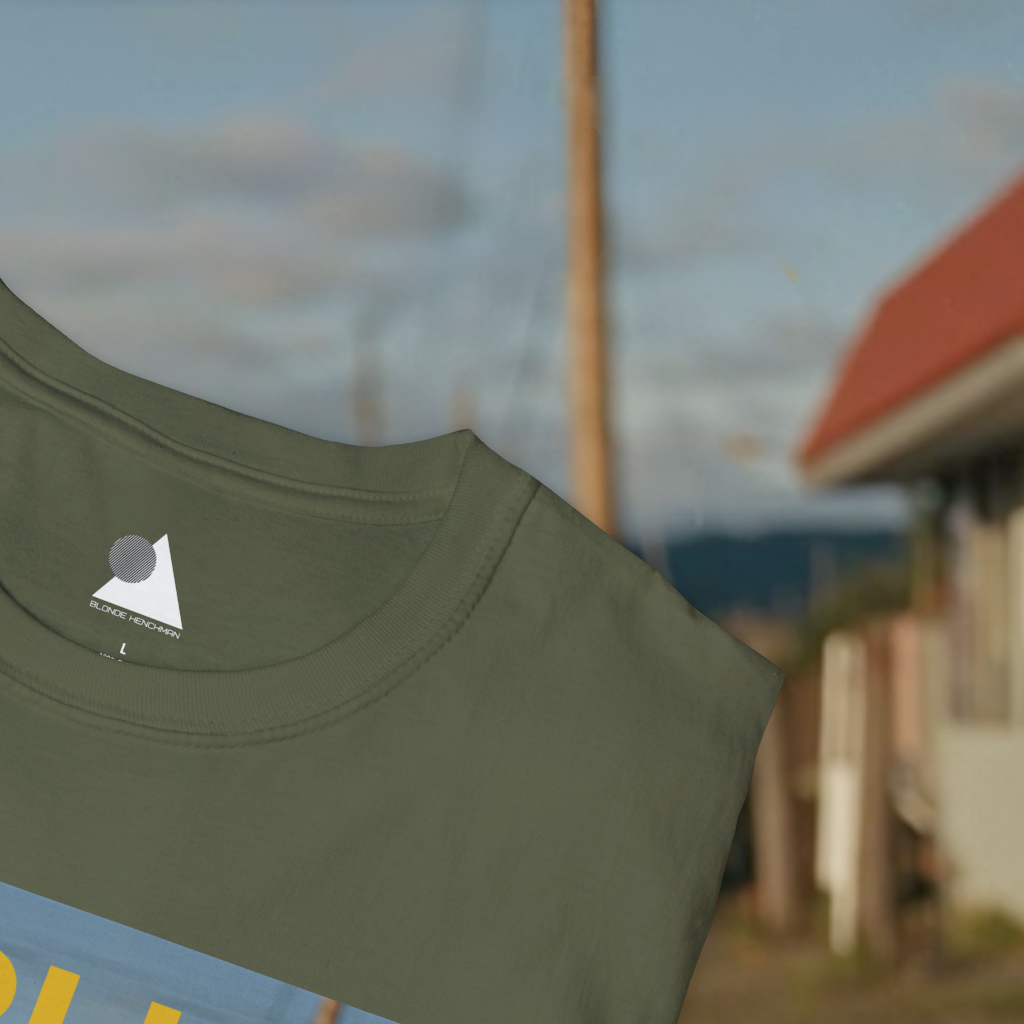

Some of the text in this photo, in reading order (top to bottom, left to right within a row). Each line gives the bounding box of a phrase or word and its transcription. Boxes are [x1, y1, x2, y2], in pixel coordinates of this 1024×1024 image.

[89, 600, 181, 639] BLONDE HENCHMAN
[119, 642, 126, 655] L
